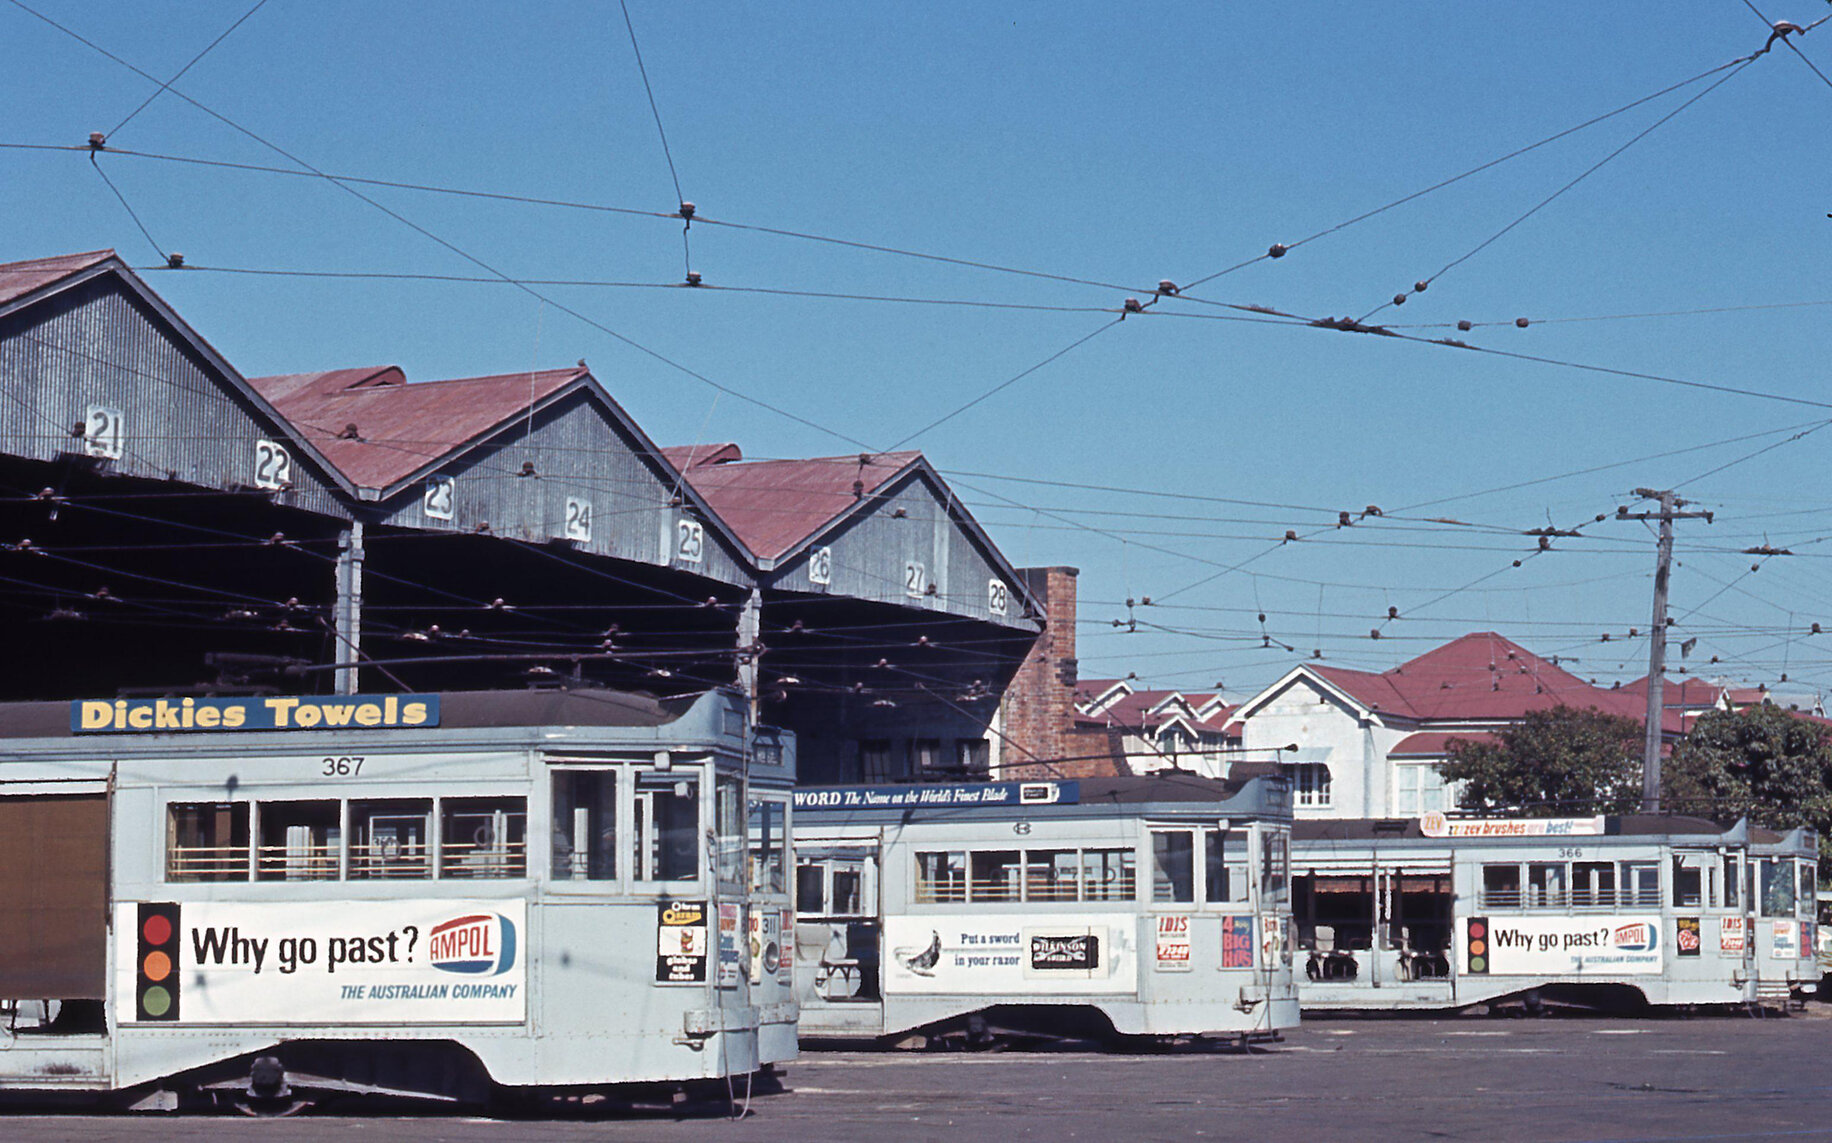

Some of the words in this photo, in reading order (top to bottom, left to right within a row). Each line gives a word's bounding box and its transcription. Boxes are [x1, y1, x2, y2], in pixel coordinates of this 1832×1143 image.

[92, 411, 120, 455] 21
[258, 446, 289, 483] 22
[427, 478, 452, 514] 23
[568, 502, 590, 535] 24
[680, 524, 701, 557] 25
[812, 552, 829, 578] 26
[907, 565, 924, 590] 27
[990, 584, 1006, 612] 28
[81, 697, 246, 729] Dickies
[265, 697, 428, 727] Towels
[322, 758, 364, 776] 367
[844, 791, 861, 804] The
[863, 790, 891, 805] Name
[892, 794, 903, 803] on
[953, 788, 980, 802] Finest
[982, 788, 1008, 801] Blade
[1425, 816, 1442, 829] ZEV
[1482, 821, 1526, 834] brushes
[1559, 849, 1582, 858] 366
[762, 918, 776, 934] 311
[1223, 916, 1233, 933] 4
[430, 924, 494, 960] AMPOL
[961, 933, 979, 945] Put
[989, 933, 1020, 944] sword
[1223, 934, 1250, 949] BIG
[1495, 929, 1533, 951] Why
[1539, 931, 1558, 951] go
[1564, 928, 1609, 951] past?
[192, 926, 268, 973] Why
[279, 937, 317, 974] go
[328, 926, 419, 973] past?
[1626, 955, 1658, 963] COMPANY
[955, 955, 965, 966] in
[967, 957, 991, 967] your
[992, 957, 1020, 966] razor
[340, 985, 365, 999] THE
[368, 985, 449, 999] AUSTRALIAN
[452, 984, 517, 999] COMPANY
